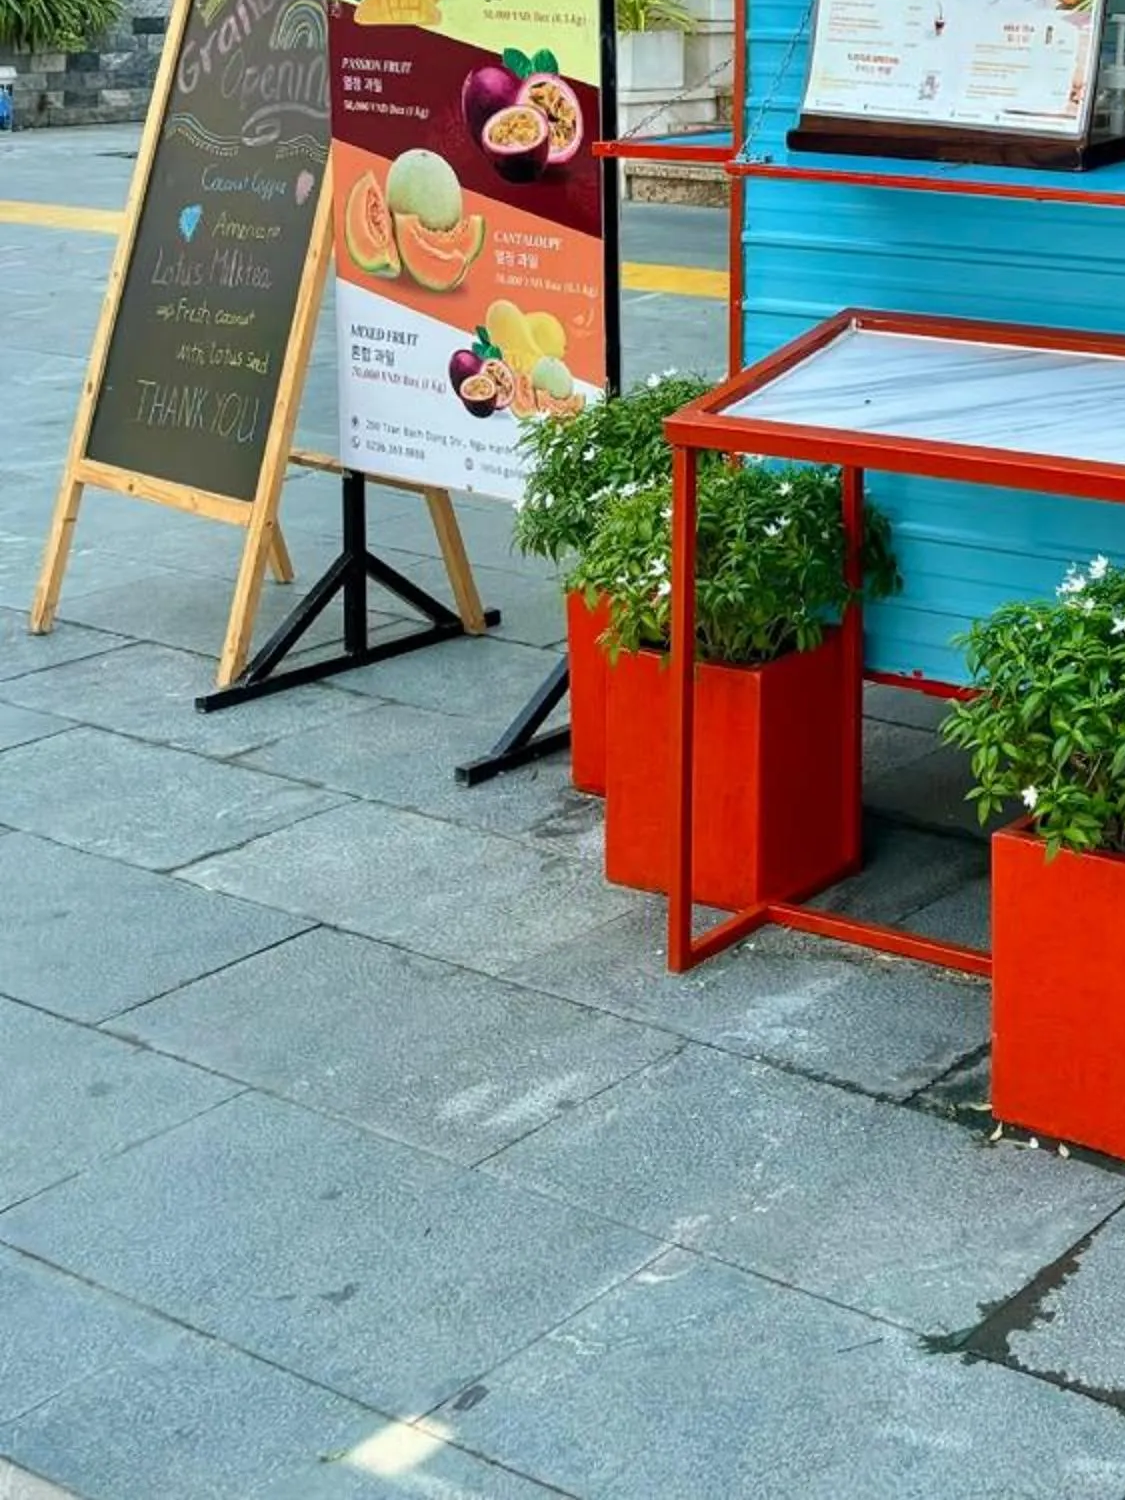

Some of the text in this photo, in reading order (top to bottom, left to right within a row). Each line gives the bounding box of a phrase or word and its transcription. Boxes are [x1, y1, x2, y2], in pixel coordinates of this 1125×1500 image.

[341, 57, 412, 74] PASSION FRUIT
[151, 246, 203, 287] Lotus
[350, 324, 419, 346] MIXED FRUIT
[137, 379, 260, 443] THANK YOU
